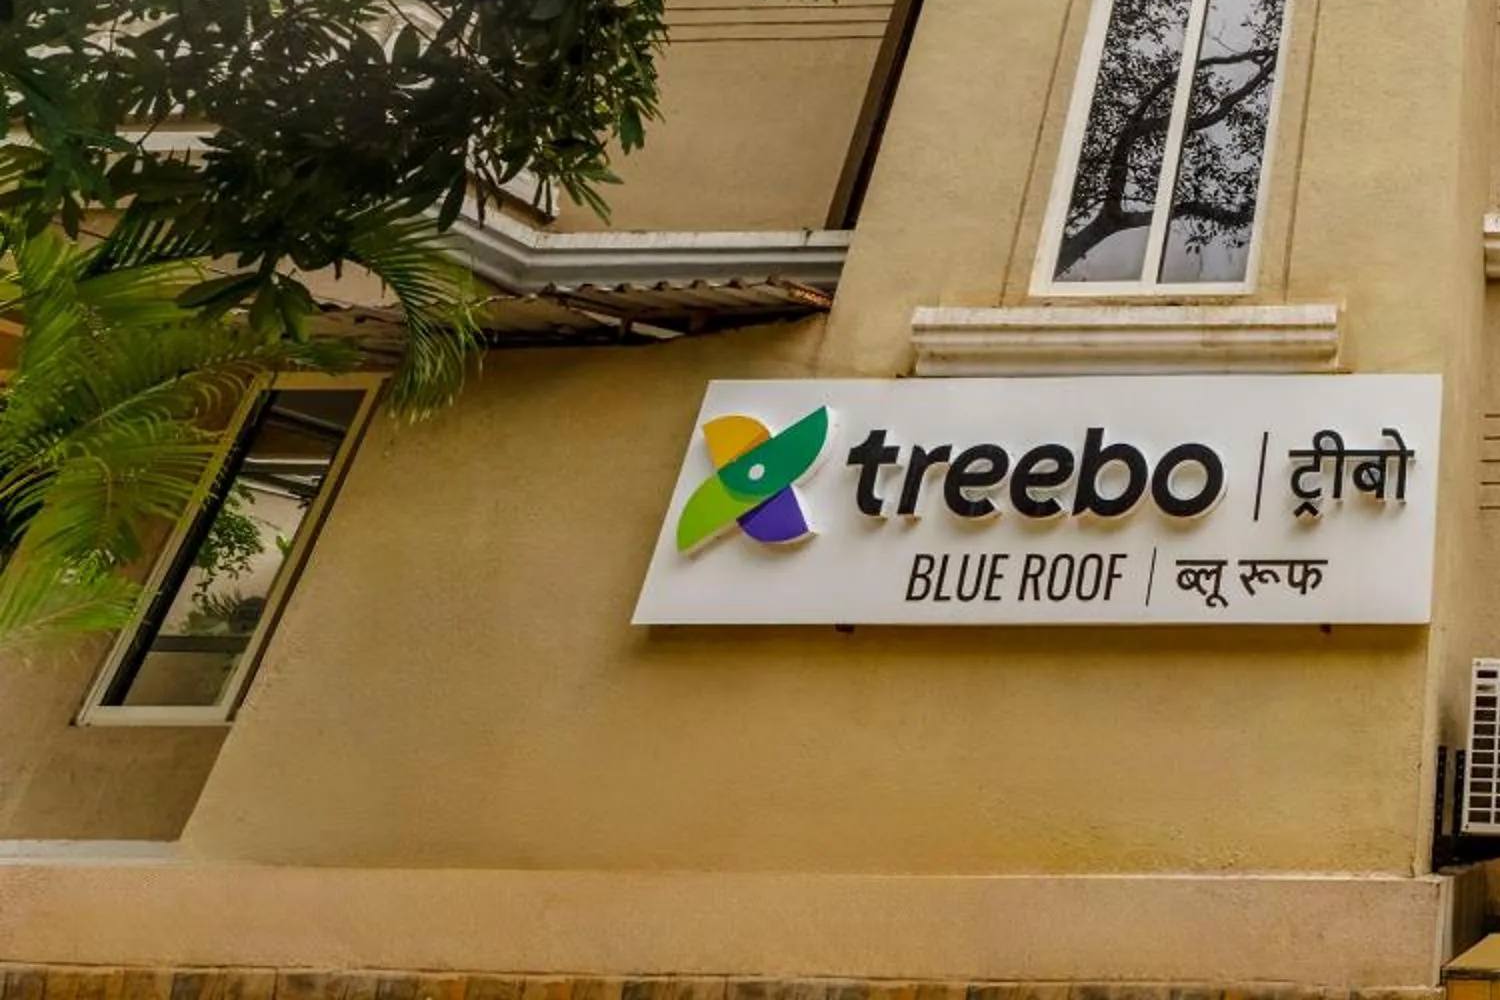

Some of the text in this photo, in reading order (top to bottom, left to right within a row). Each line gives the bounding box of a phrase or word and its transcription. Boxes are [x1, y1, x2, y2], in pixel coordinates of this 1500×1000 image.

[846, 427, 1224, 519] treebo
[1288, 428, 1415, 518] ट्रीबो
[905, 553, 1128, 602] BLUE ROOF
[1175, 559, 1329, 608] ब्लू रूफ
